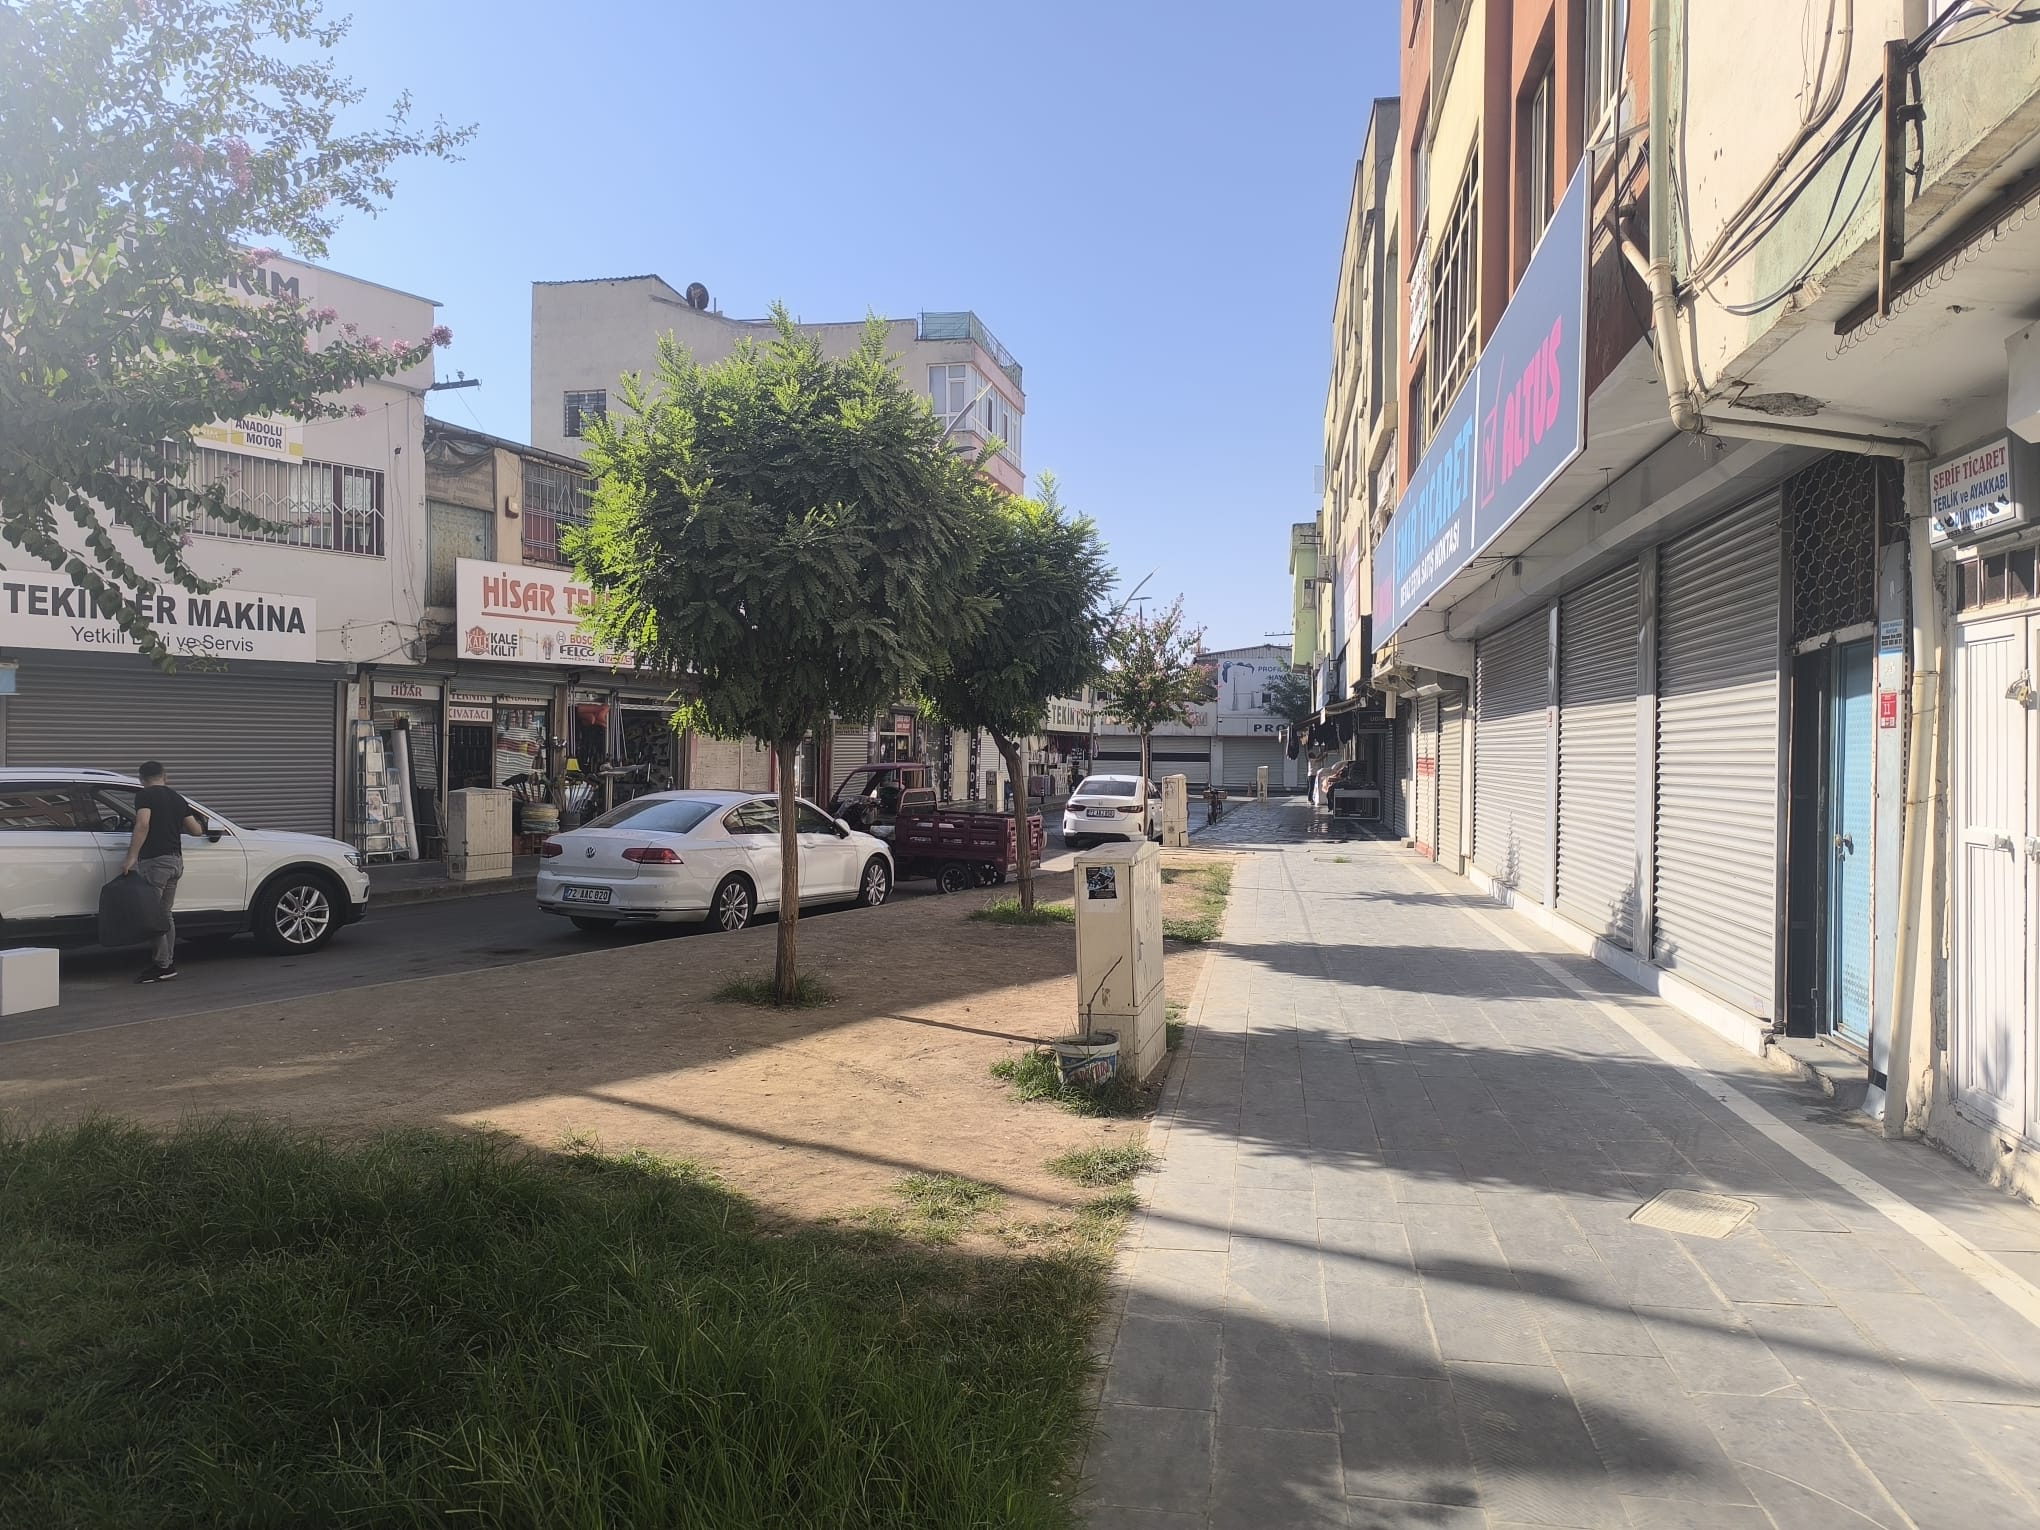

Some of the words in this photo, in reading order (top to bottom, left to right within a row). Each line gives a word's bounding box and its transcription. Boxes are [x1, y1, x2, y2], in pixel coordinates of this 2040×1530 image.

[1501, 314, 1562, 485] ALTUS
[235, 419, 283, 437] ANADOLU
[245, 431, 283, 449] MOTOR
[1419, 414, 1473, 553] TİCARET
[1933, 463, 1960, 495] ŞERİF
[1962, 446, 2006, 480] TİCARET
[1933, 489, 1959, 513] TERLİK
[1960, 491, 1969, 504] ve
[1969, 472, 2009, 501] AYAKKABI
[1954, 502, 1988, 528] DÜNYASI
[483, 571, 556, 616] HİSAR
[188, 597, 306, 634] MAKİNA
[71, 626, 125, 644] Yetkili
[203, 634, 254, 653] Servis
[490, 632, 518, 646] KALE
[560, 645, 596, 657] FELCO
[570, 634, 593, 645] BOSC
[1051, 701, 1075, 726] TEKİN
[579, 889, 594, 899] AAC
